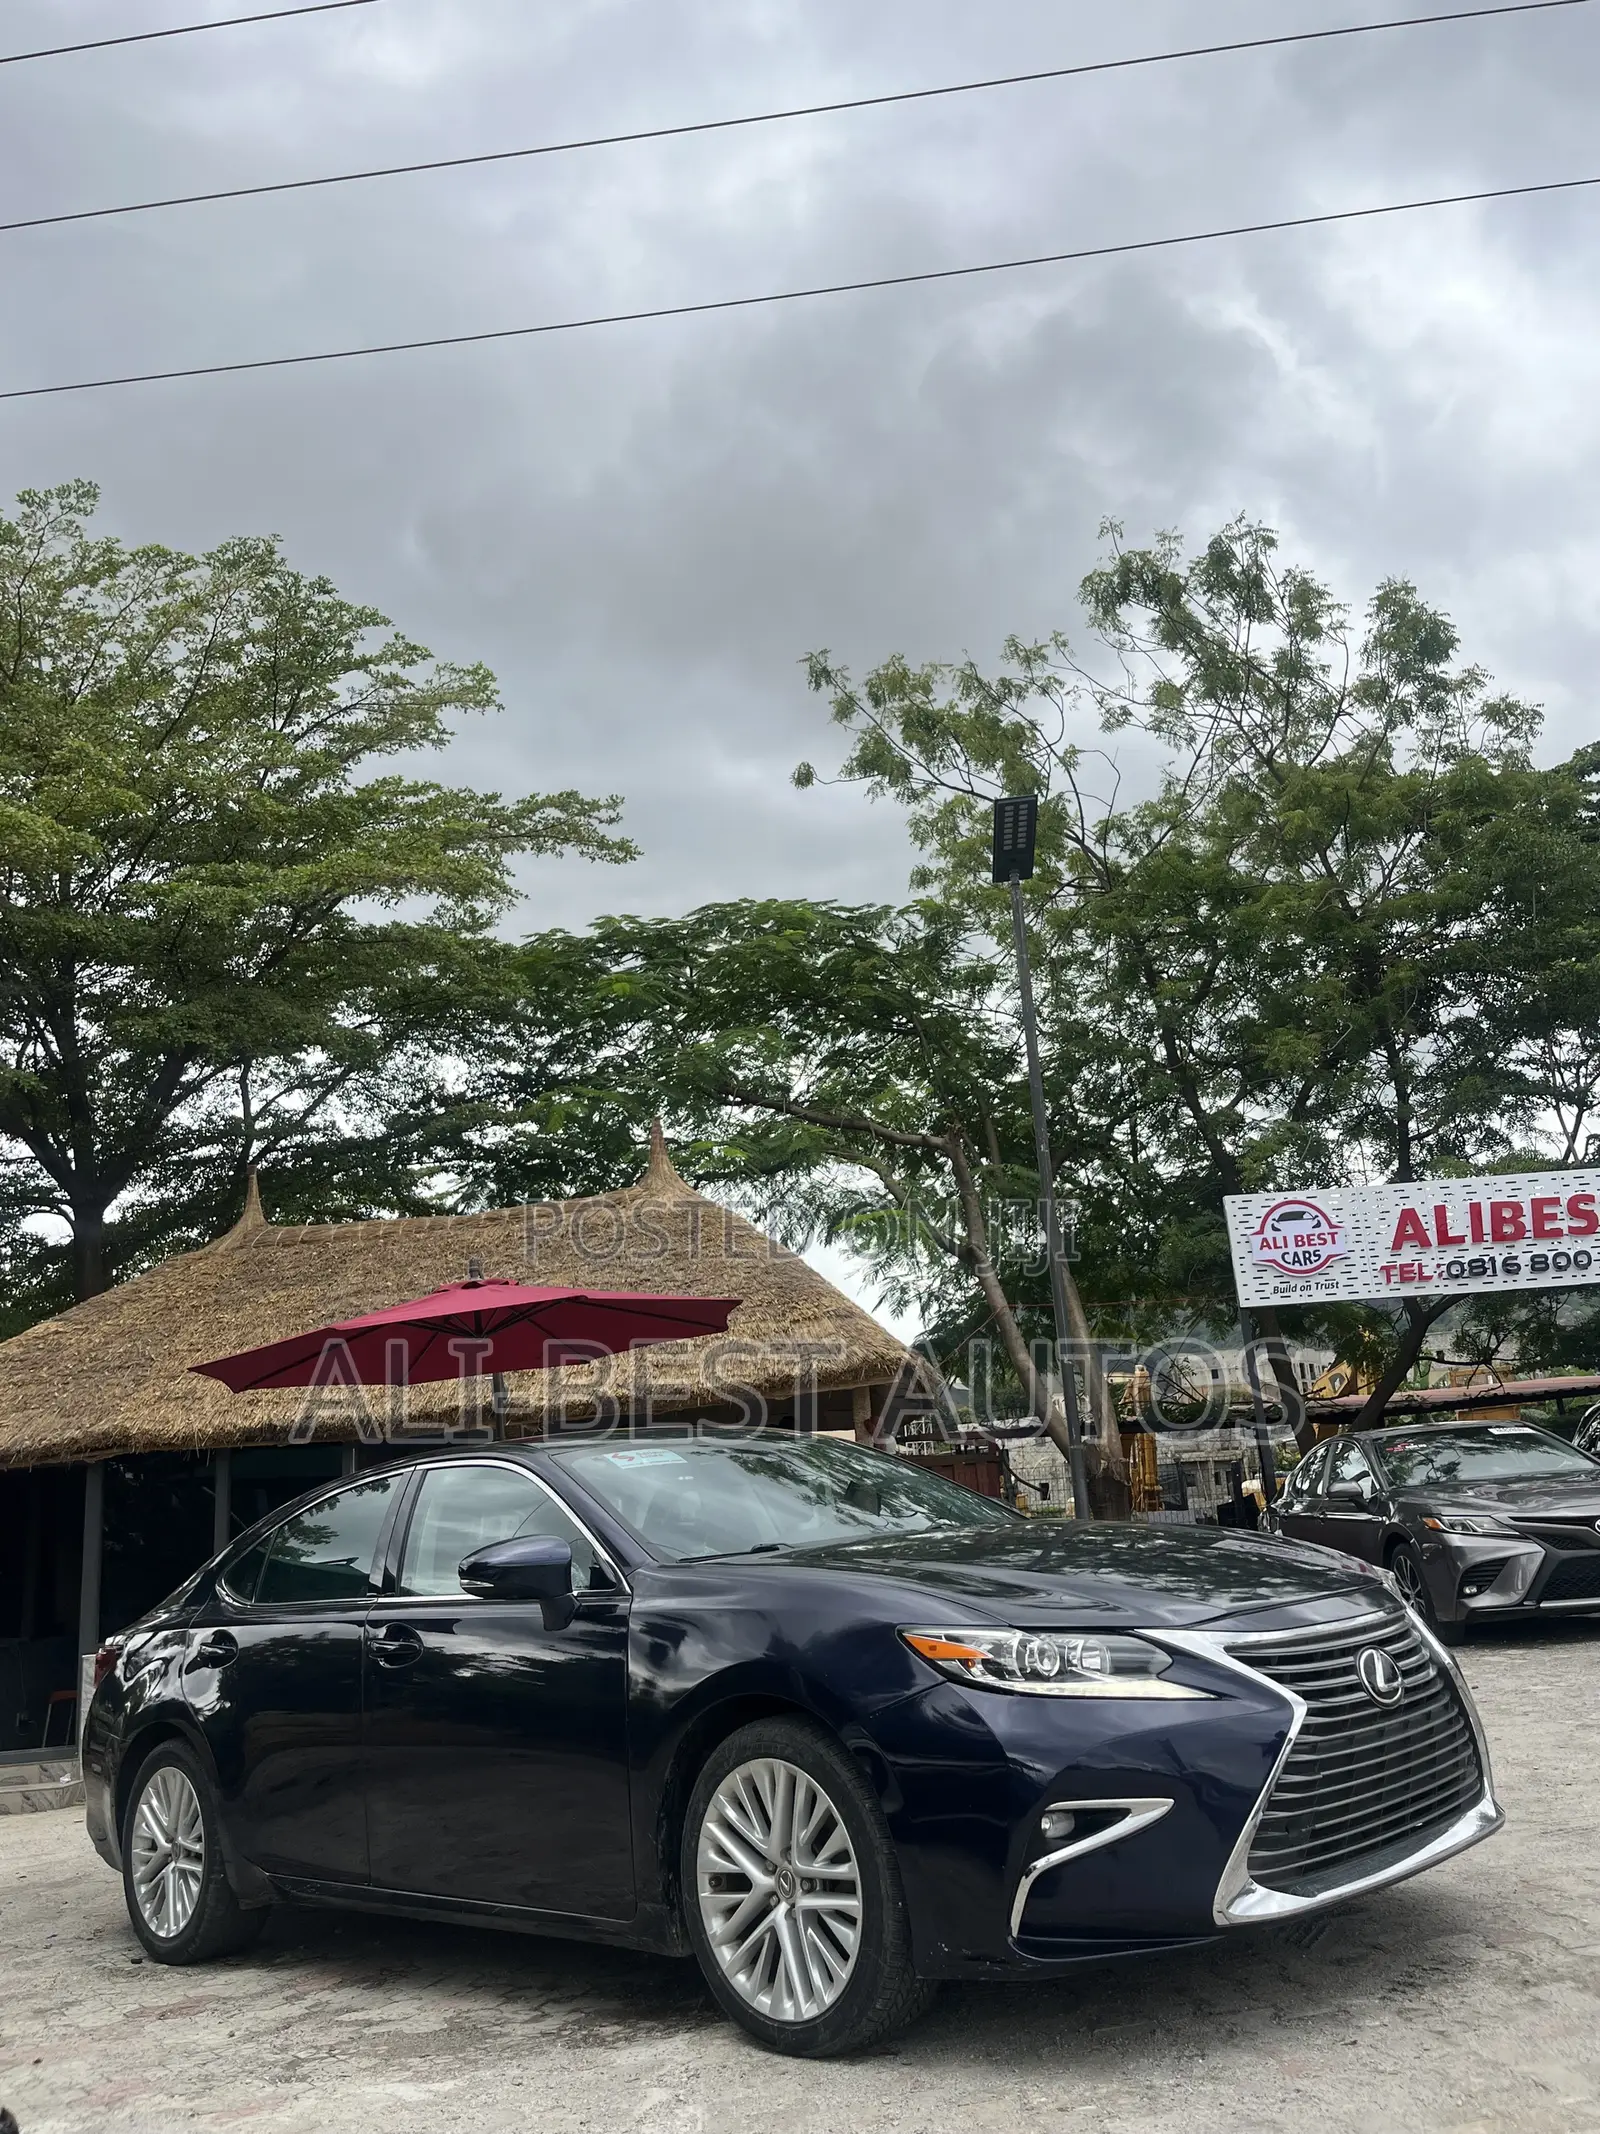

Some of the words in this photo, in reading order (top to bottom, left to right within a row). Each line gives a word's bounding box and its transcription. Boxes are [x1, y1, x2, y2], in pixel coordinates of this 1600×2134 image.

[1391, 1193, 1600, 1251] ALIBES
[1259, 1236, 1288, 1250] ALI
[1294, 1232, 1338, 1248] BEST
[1281, 1249, 1321, 1266] CARS
[1273, 1284, 1298, 1294] Build
[1315, 1281, 1339, 1290] Trust
